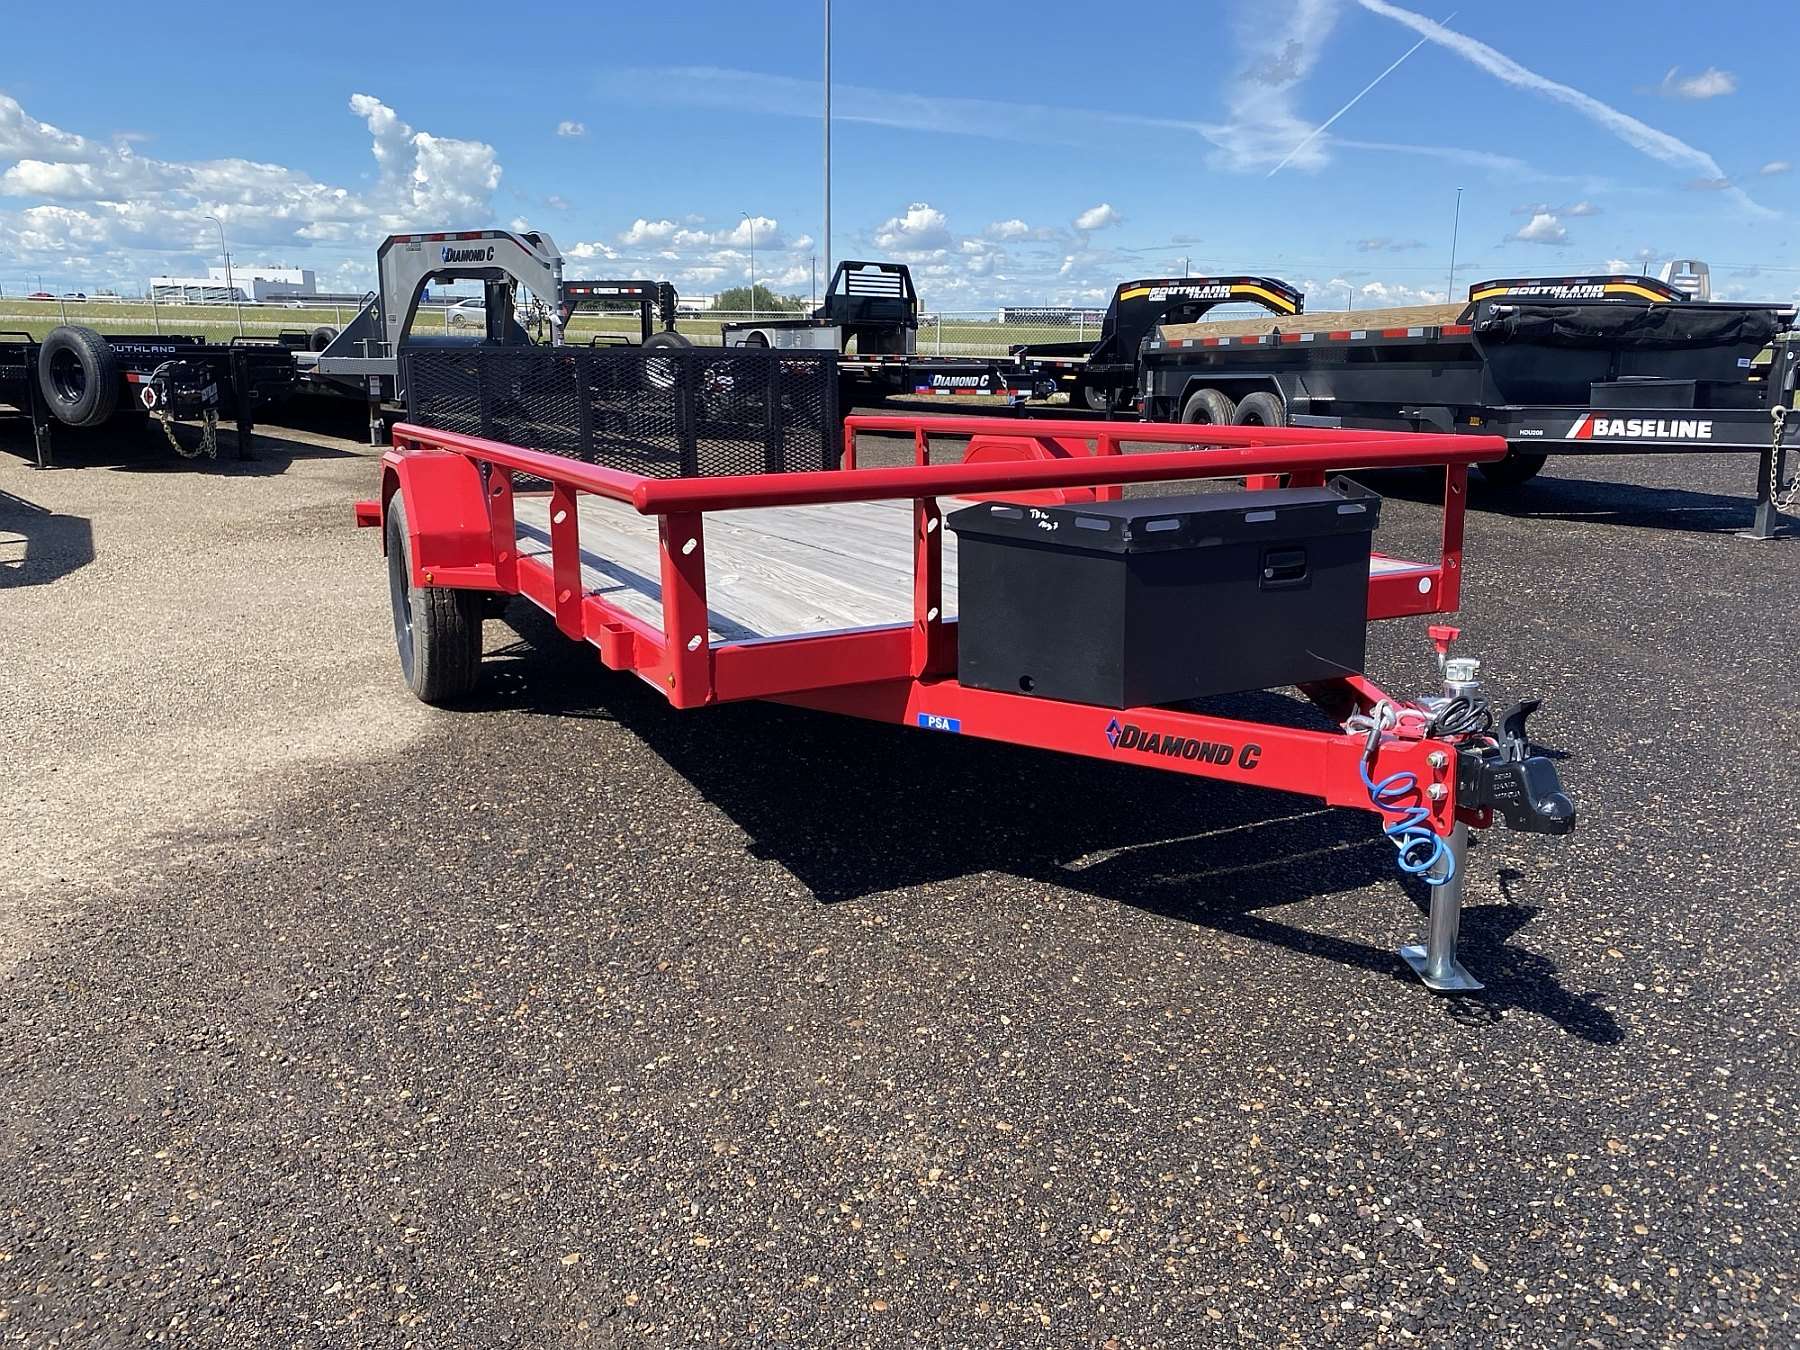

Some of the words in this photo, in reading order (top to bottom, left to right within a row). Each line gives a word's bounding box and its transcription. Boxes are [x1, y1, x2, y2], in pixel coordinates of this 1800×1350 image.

[446, 248, 485, 263] DIAMOND
[486, 246, 495, 262] C
[1150, 285, 1231, 295] SOUTHLAND
[1507, 284, 1604, 295] SOUTHLAND
[108, 344, 176, 353] OUTHLAND
[933, 374, 979, 386] DIAMOND
[980, 374, 990, 386] C
[1593, 419, 1713, 439] BASELINE
[928, 716, 951, 731] PSA
[1119, 725, 1235, 766] DIAMOND
[1238, 744, 1263, 770] C
